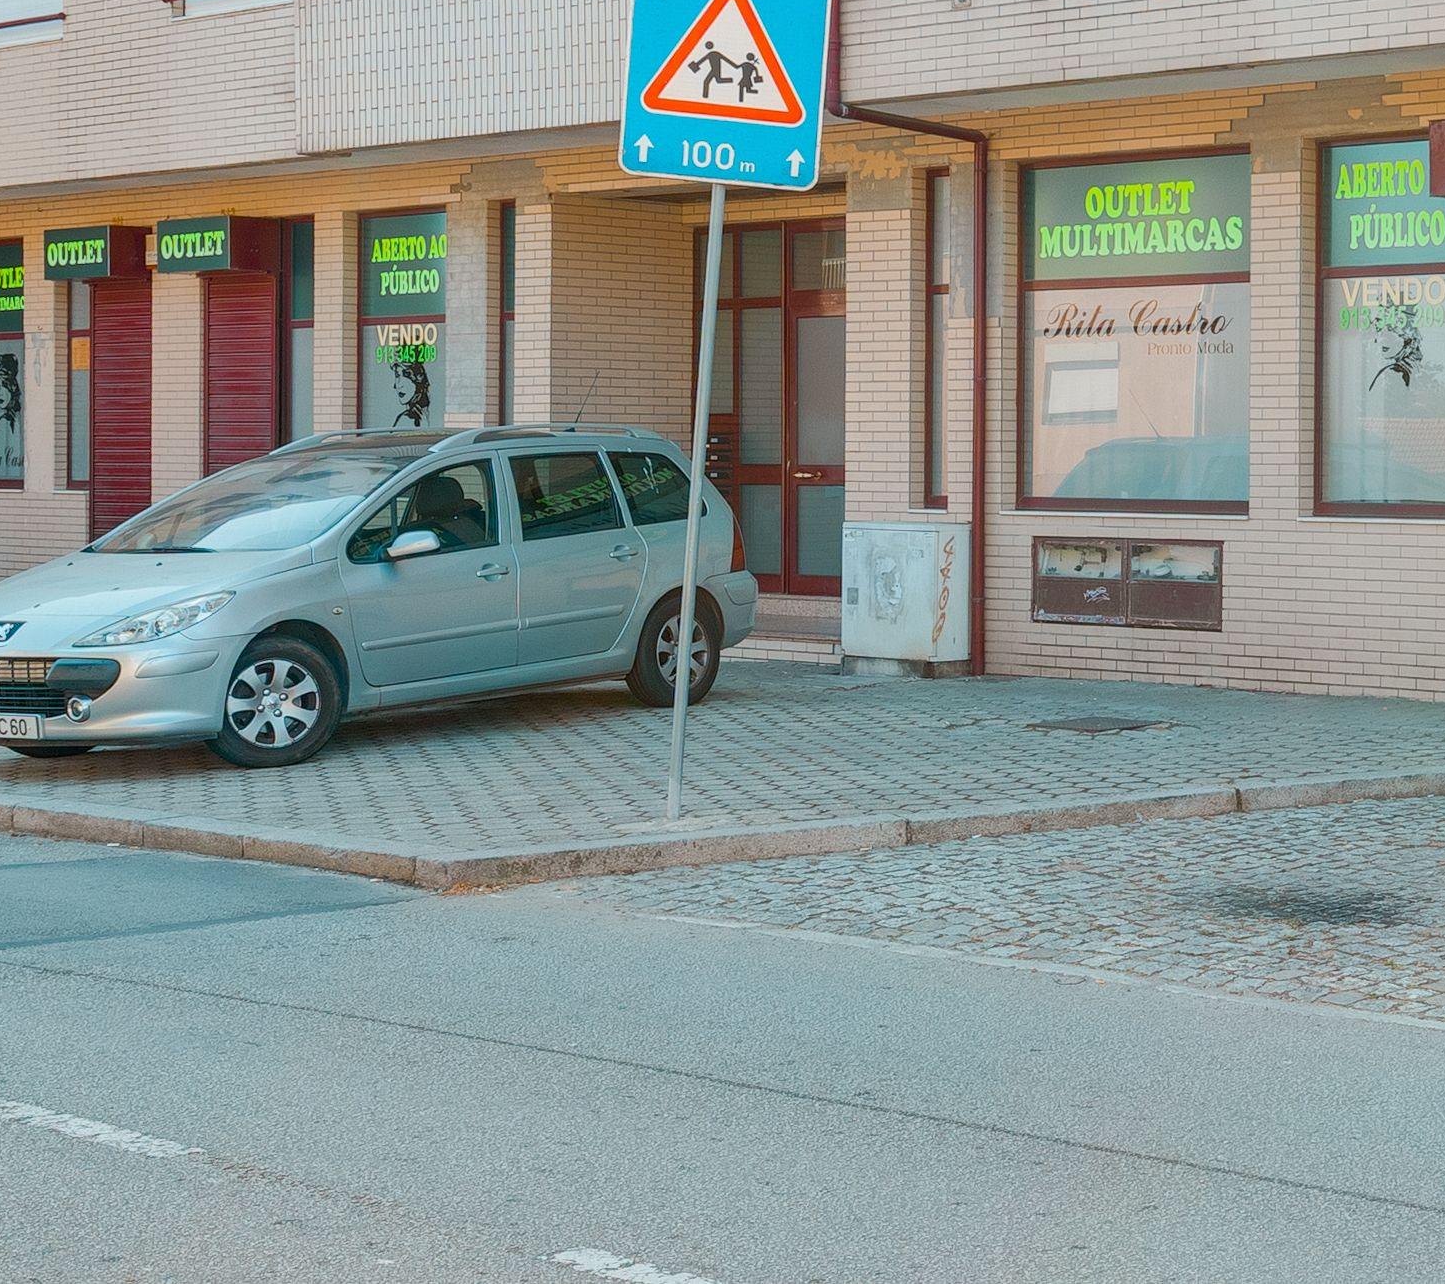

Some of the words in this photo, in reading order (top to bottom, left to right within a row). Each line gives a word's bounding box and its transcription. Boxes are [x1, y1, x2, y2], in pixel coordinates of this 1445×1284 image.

[682, 139, 735, 170] 100
[739, 161, 755, 173] m
[1335, 159, 1425, 199] ABERTO
[1085, 180, 1195, 219] OUTLET
[160, 230, 225, 260] OUTLET
[371, 236, 426, 263] ABERTO
[1039, 215, 1244, 259] MULTIMARCAS
[46, 238, 105, 267] OUTLET
[380, 264, 440, 296] PÚBLICO
[1043, 302, 1117, 340] Rita
[1128, 299, 1235, 337] Castro
[1339, 305, 1371, 330] 913
[376, 323, 438, 346] VENDO
[1147, 342, 1193, 356] Pronto
[1196, 340, 1235, 355] Moda
[376, 345, 394, 364] 913
[397, 345, 416, 363] 345
